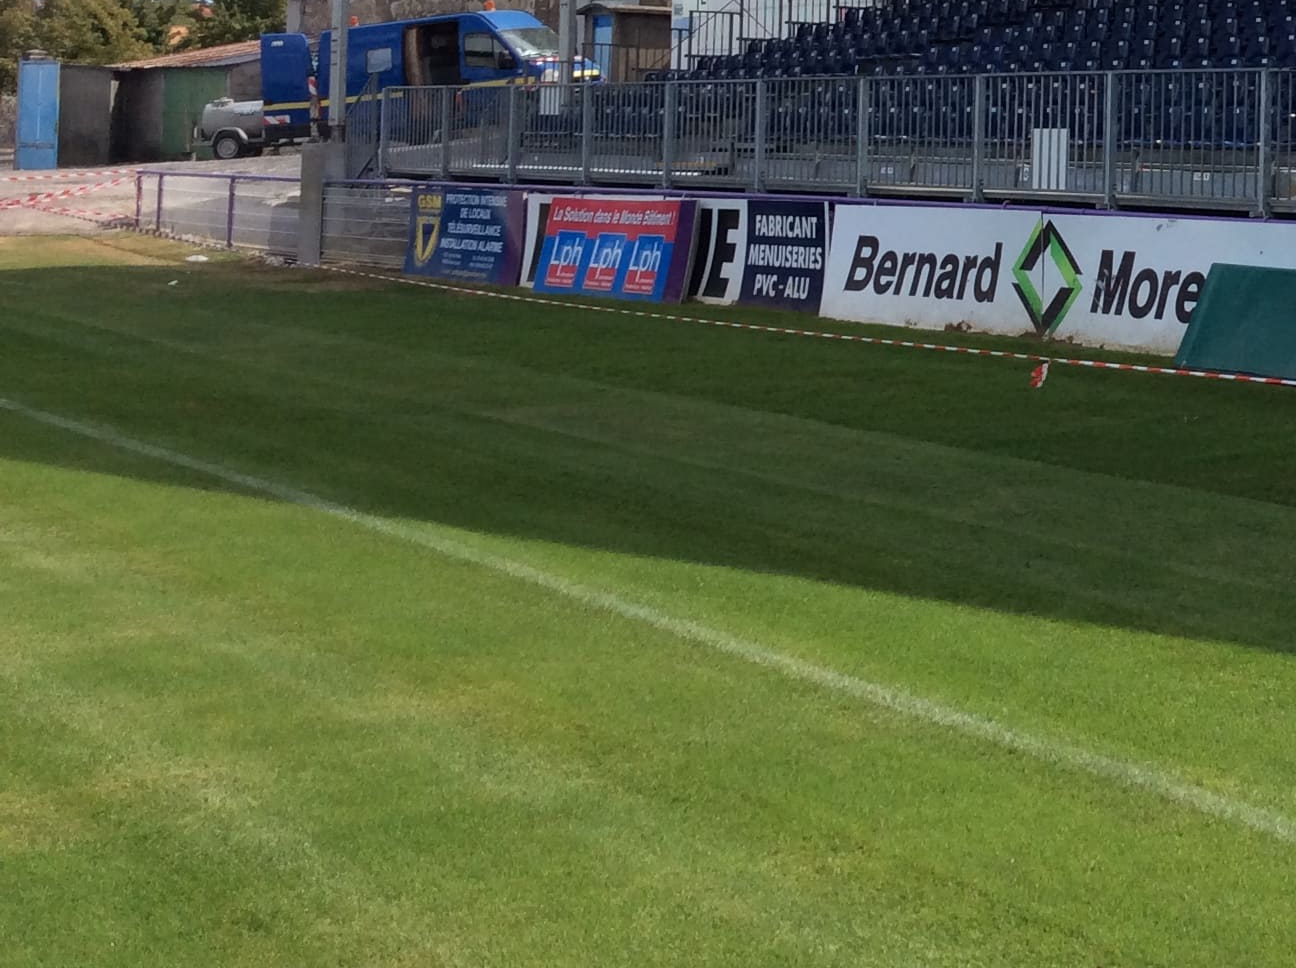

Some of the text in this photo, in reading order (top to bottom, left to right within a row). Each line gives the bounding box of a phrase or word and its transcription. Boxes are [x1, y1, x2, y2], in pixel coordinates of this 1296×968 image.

[417, 195, 441, 209] GSM
[460, 207, 468, 219] DE
[553, 206, 563, 221] La
[563, 206, 594, 223] Solution
[594, 208, 612, 224] dans
[611, 209, 620, 224] le
[755, 214, 818, 240] FABRICANT
[550, 235, 661, 282] Lph Lph Lph
[747, 243, 823, 271] MENUISERIES
[753, 274, 778, 298] PVC
[783, 275, 810, 300] ALU
[843, 234, 1206, 325] Bernard More
